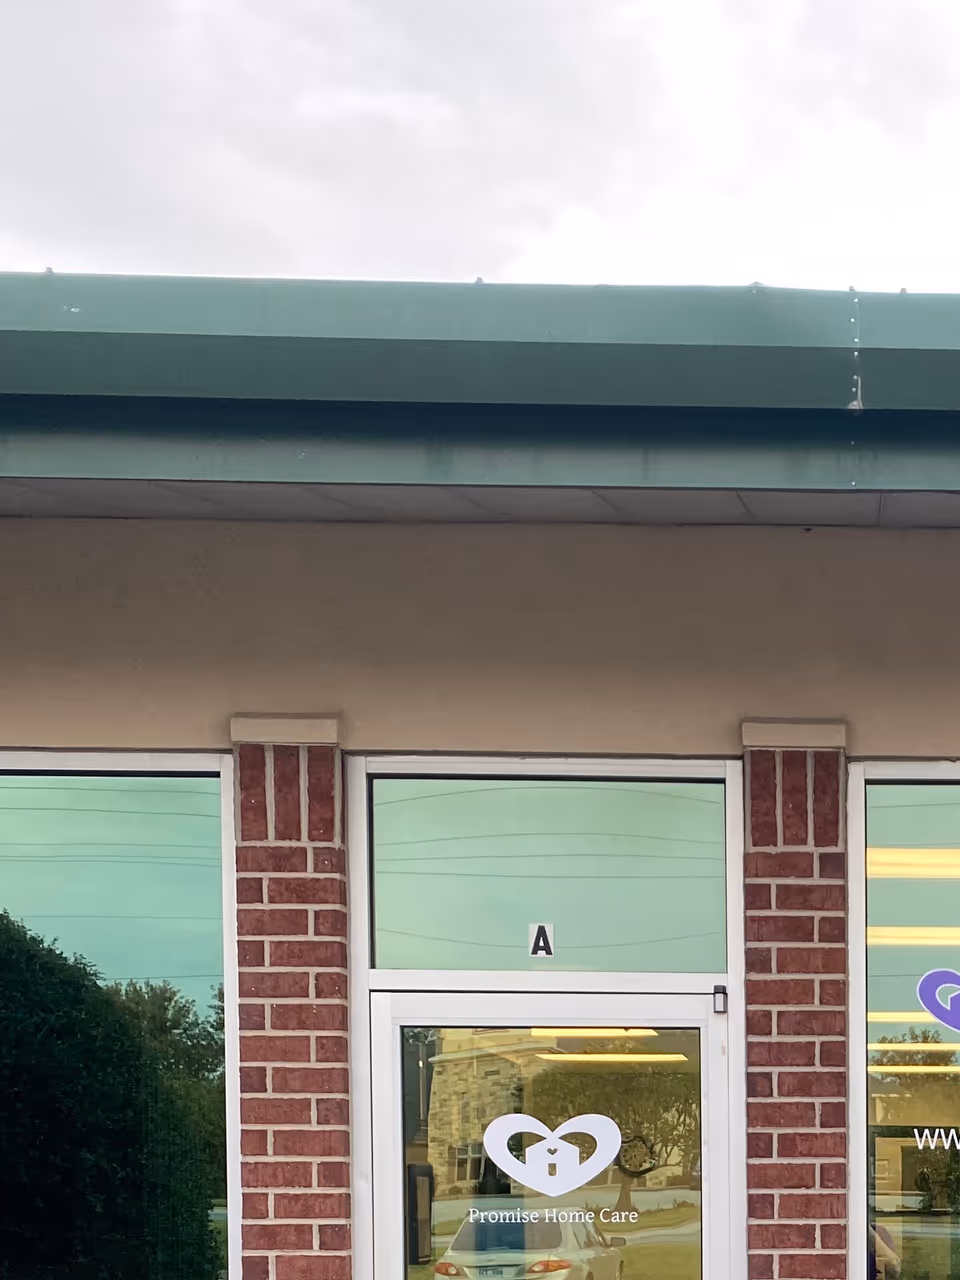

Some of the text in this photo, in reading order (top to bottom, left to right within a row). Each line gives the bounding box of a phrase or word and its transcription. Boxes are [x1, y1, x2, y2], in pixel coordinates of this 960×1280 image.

[530, 925, 553, 956] A
[468, 1207, 639, 1224] Promise Home Care
